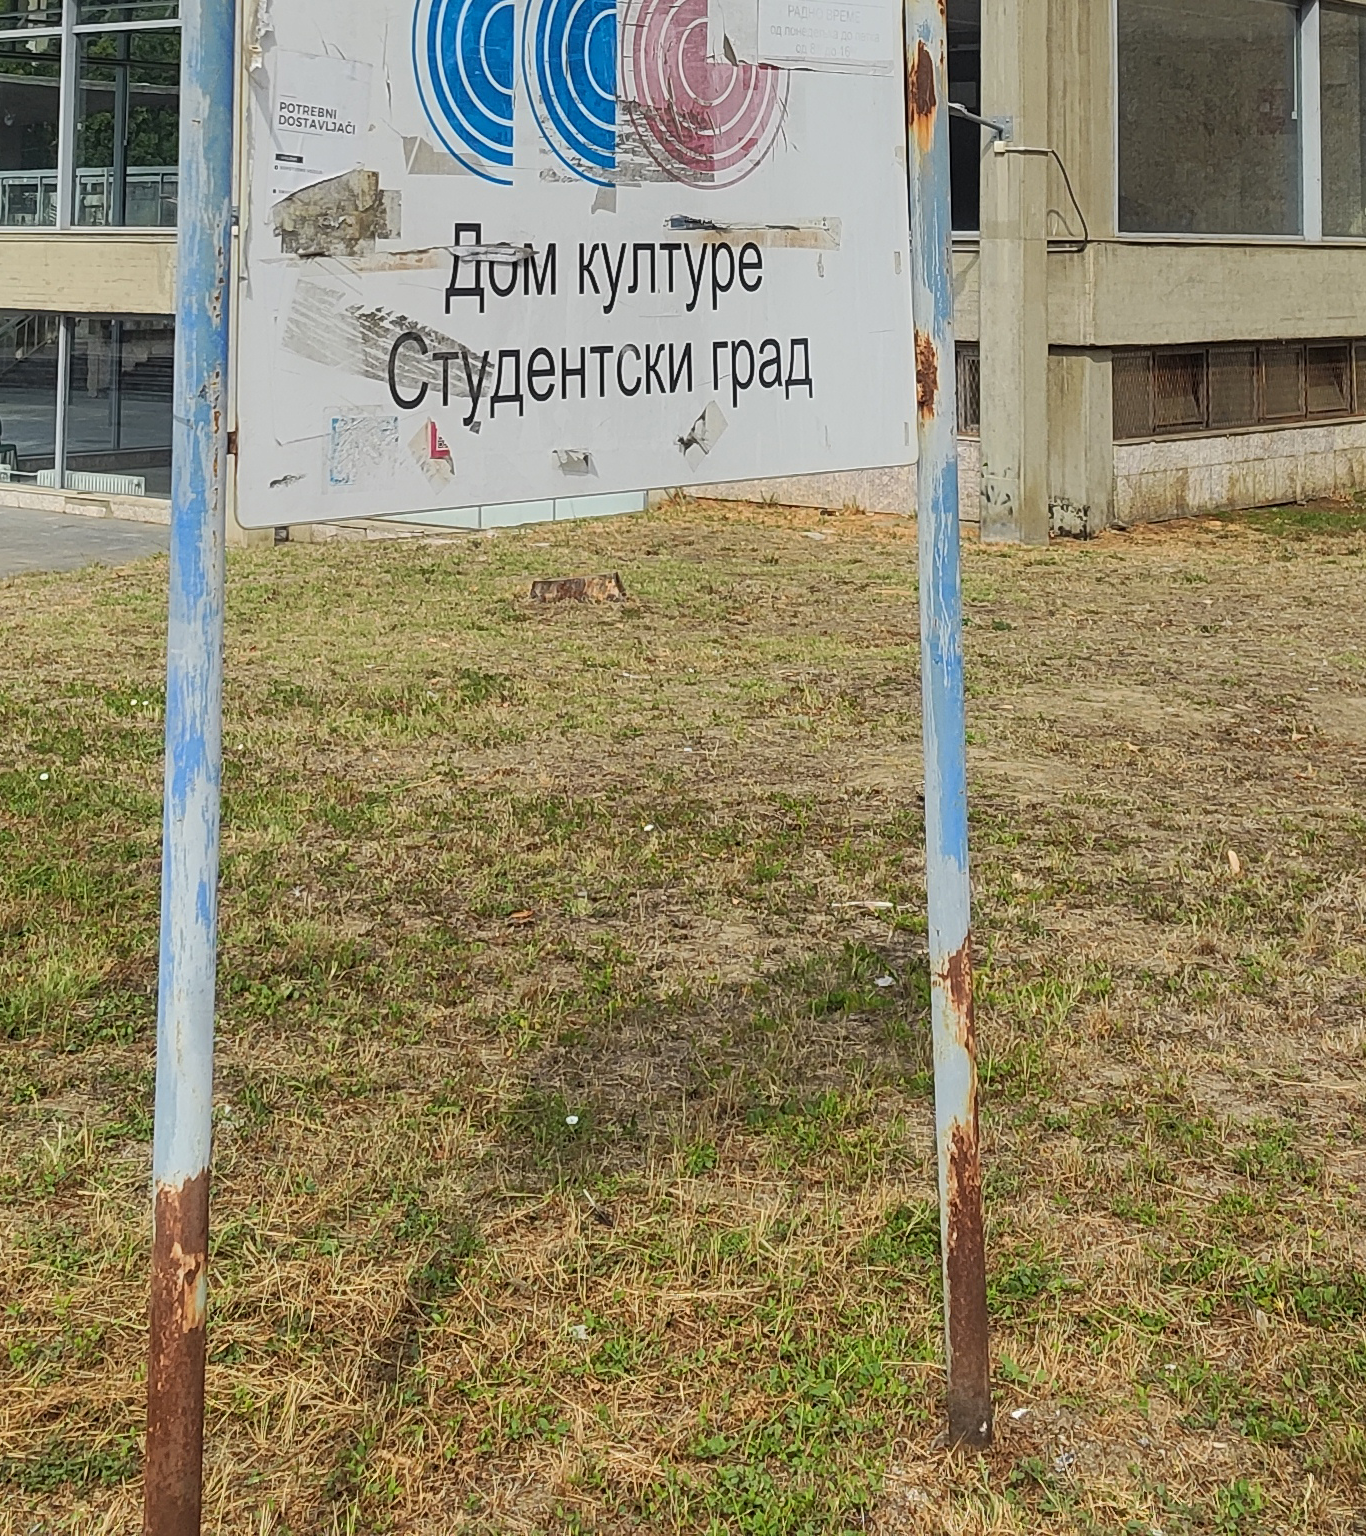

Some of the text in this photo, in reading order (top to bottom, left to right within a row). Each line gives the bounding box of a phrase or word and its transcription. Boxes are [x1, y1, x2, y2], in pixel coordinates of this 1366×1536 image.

[787, 4, 861, 23] РАДНО ВРЕМЕ
[770, 24, 782, 37] од
[840, 30, 853, 41] до
[279, 101, 337, 120] POTREBNI
[278, 114, 356, 135] DOSTAVLJAČI
[444, 222, 764, 315] Дом културе
[387, 330, 814, 427] Студентски град
